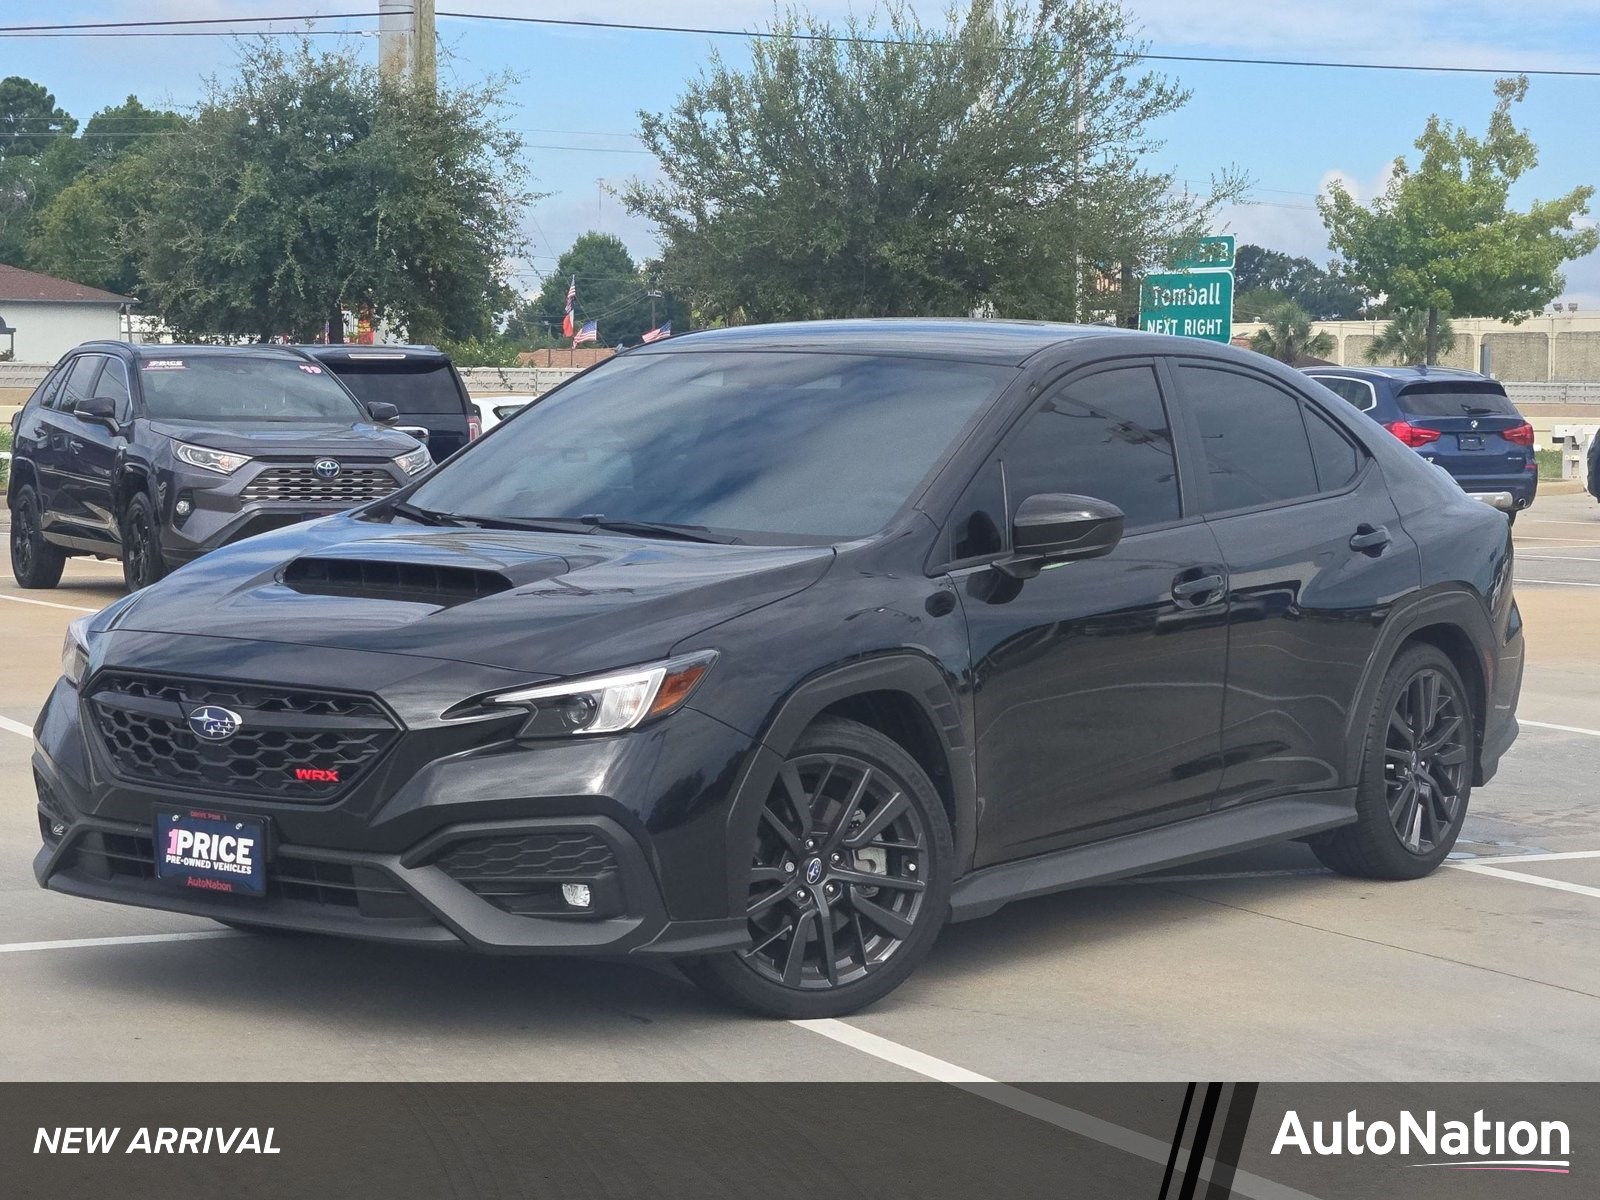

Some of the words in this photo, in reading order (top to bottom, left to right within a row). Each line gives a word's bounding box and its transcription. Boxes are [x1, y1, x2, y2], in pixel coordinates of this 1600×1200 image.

[1152, 282, 1221, 306] Tomball
[1147, 319, 1178, 336] NEXT
[1184, 318, 1223, 336] RIGHT
[295, 768, 339, 782] WRX
[165, 855, 212, 870] PRE-OWNED
[213, 861, 252, 875] VEHICLES
[187, 876, 232, 892] AutoNation
